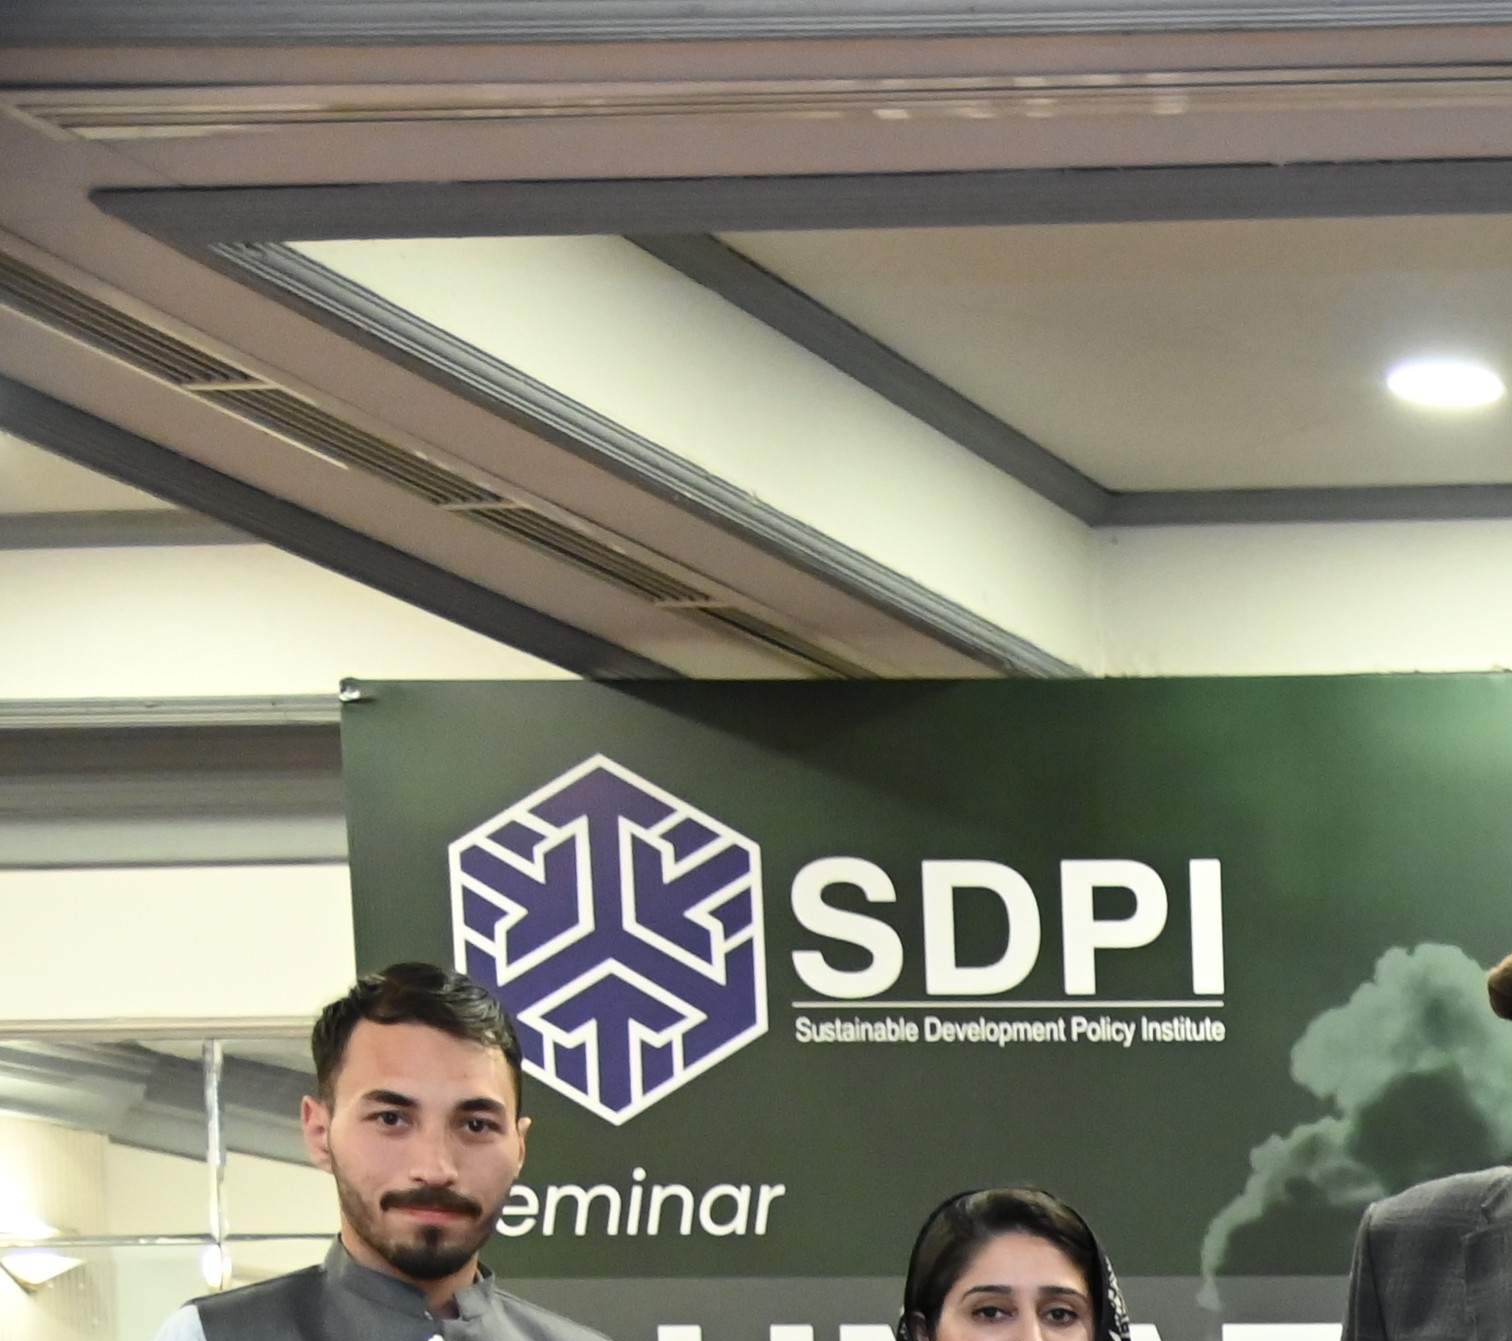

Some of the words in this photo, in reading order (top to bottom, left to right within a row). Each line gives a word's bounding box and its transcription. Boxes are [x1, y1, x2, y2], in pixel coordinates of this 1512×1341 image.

[791, 857, 1224, 997] SDPI
[795, 1016, 919, 1042] Sustainable
[925, 1016, 1066, 1047] Development
[1072, 1016, 1135, 1047] Policy
[1141, 1016, 1226, 1042] Institute
[496, 1166, 786, 1237] eminar
